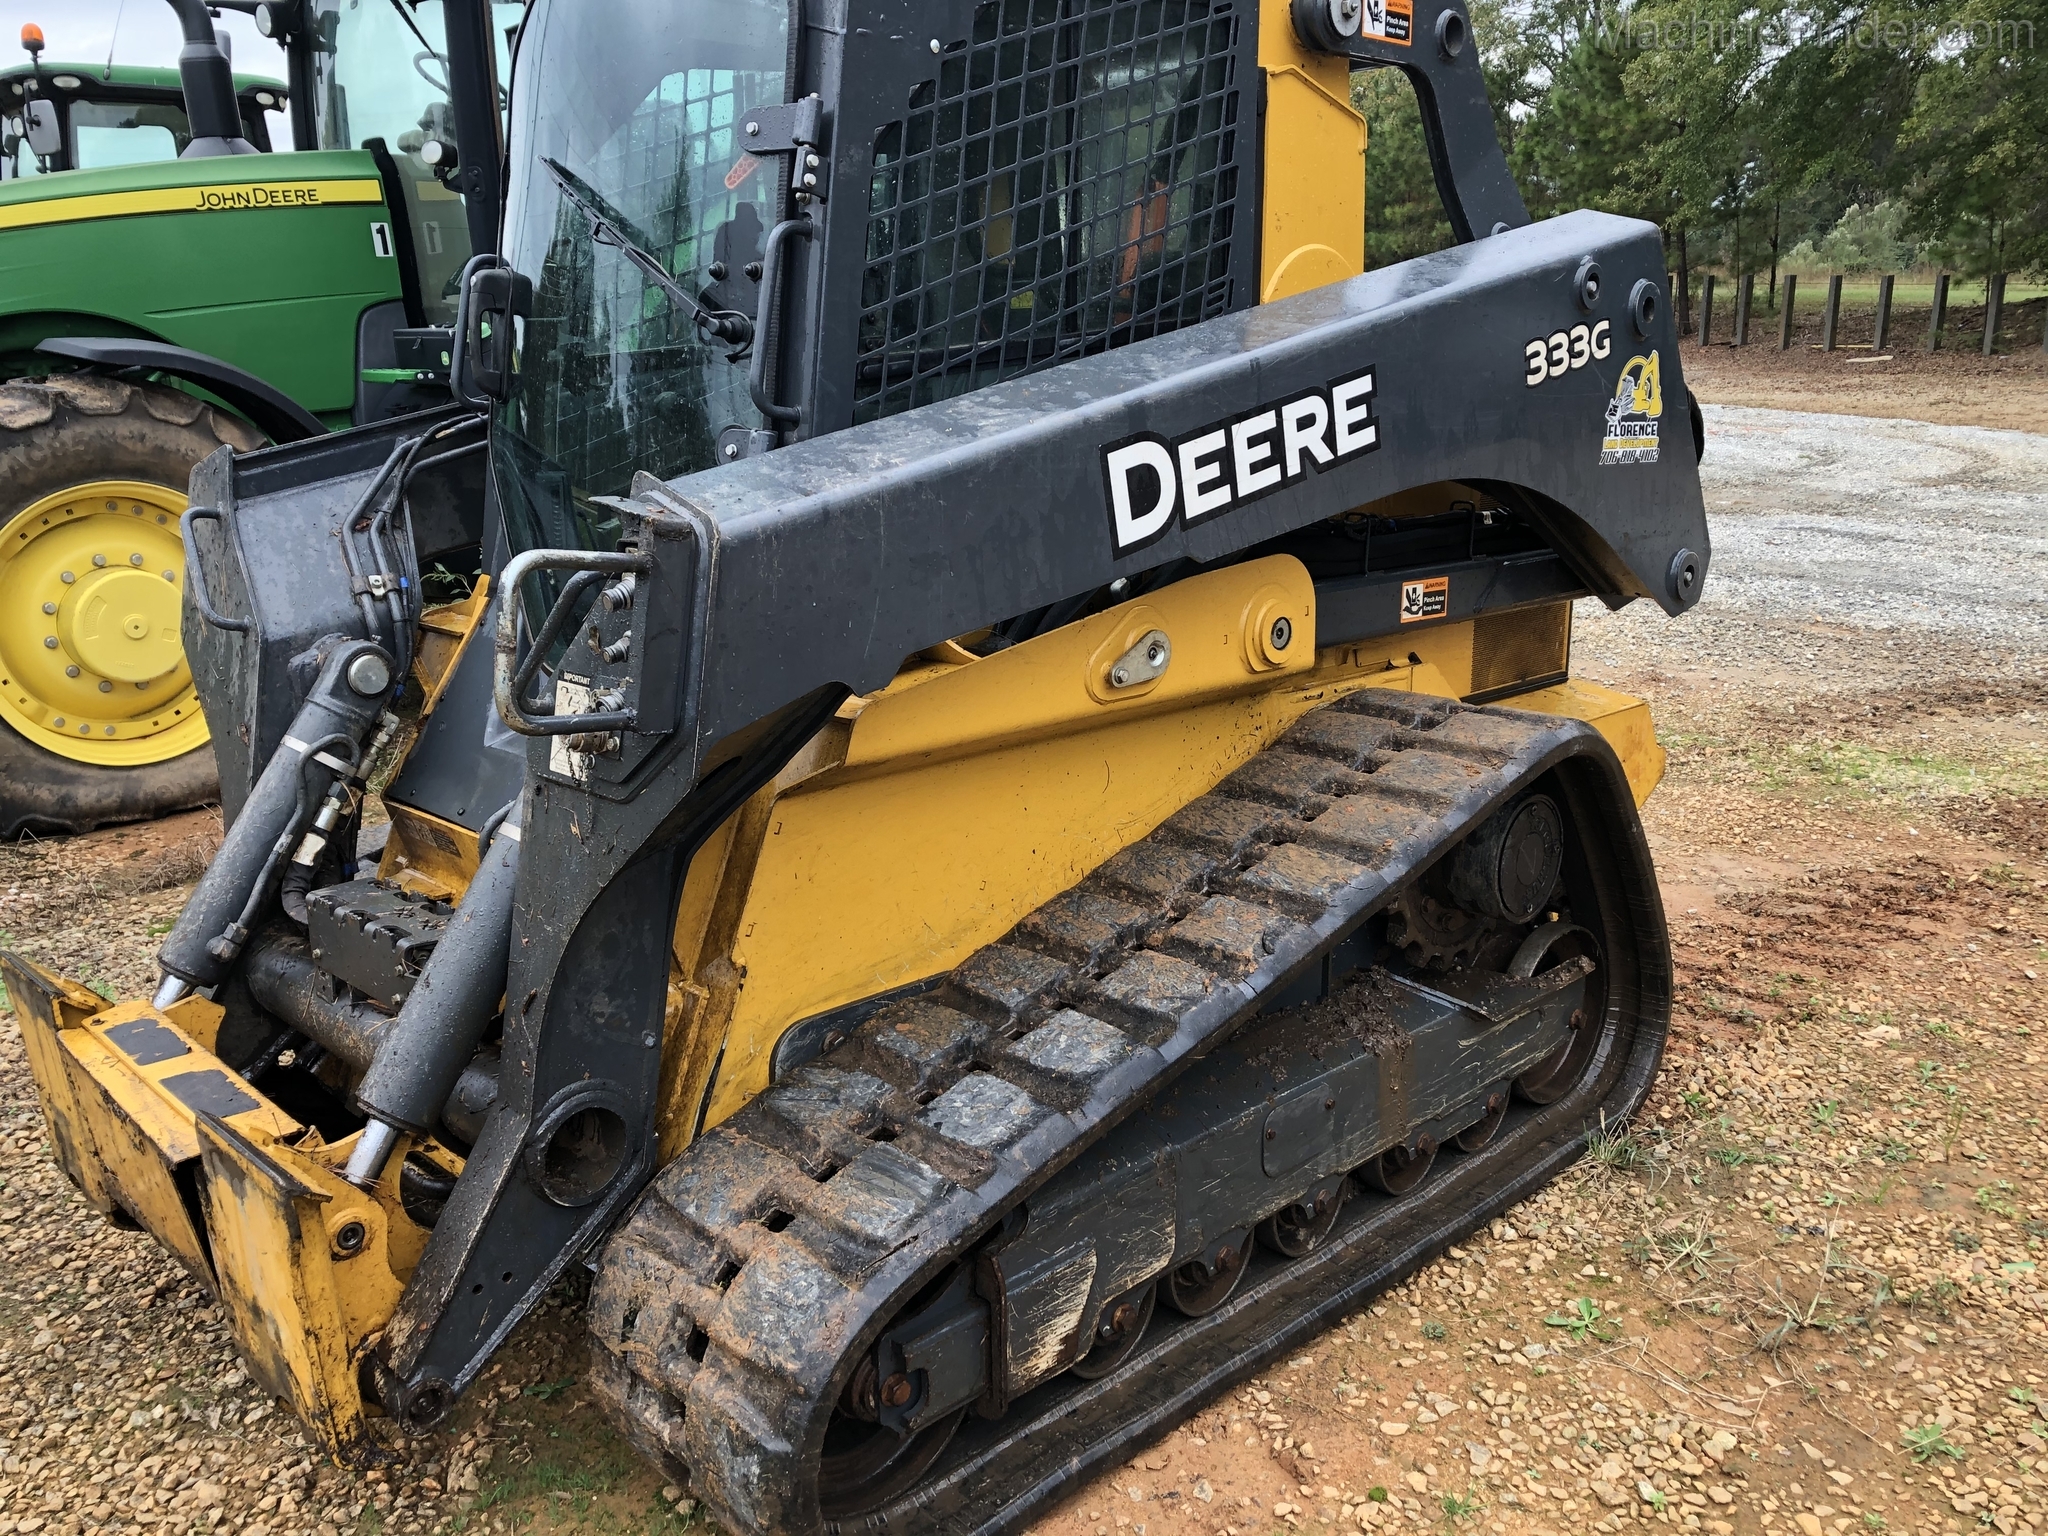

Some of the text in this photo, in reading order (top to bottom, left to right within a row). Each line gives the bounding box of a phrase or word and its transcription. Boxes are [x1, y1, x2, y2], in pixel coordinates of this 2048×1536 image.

[1386, 15, 1409, 27] Pinch Area
[196, 188, 319, 207] JOHN DEERE
[376, 224, 389, 255] 1
[1526, 320, 1611, 386] 333G
[1608, 423, 1657, 437] FLORENCE
[1604, 438, 1658, 449] LAND DEVELOPMENT
[1107, 374, 1376, 548] DEERE
[1600, 449, 1660, 465] 706-818-4102
[564, 672, 591, 686] IMPORTANT
